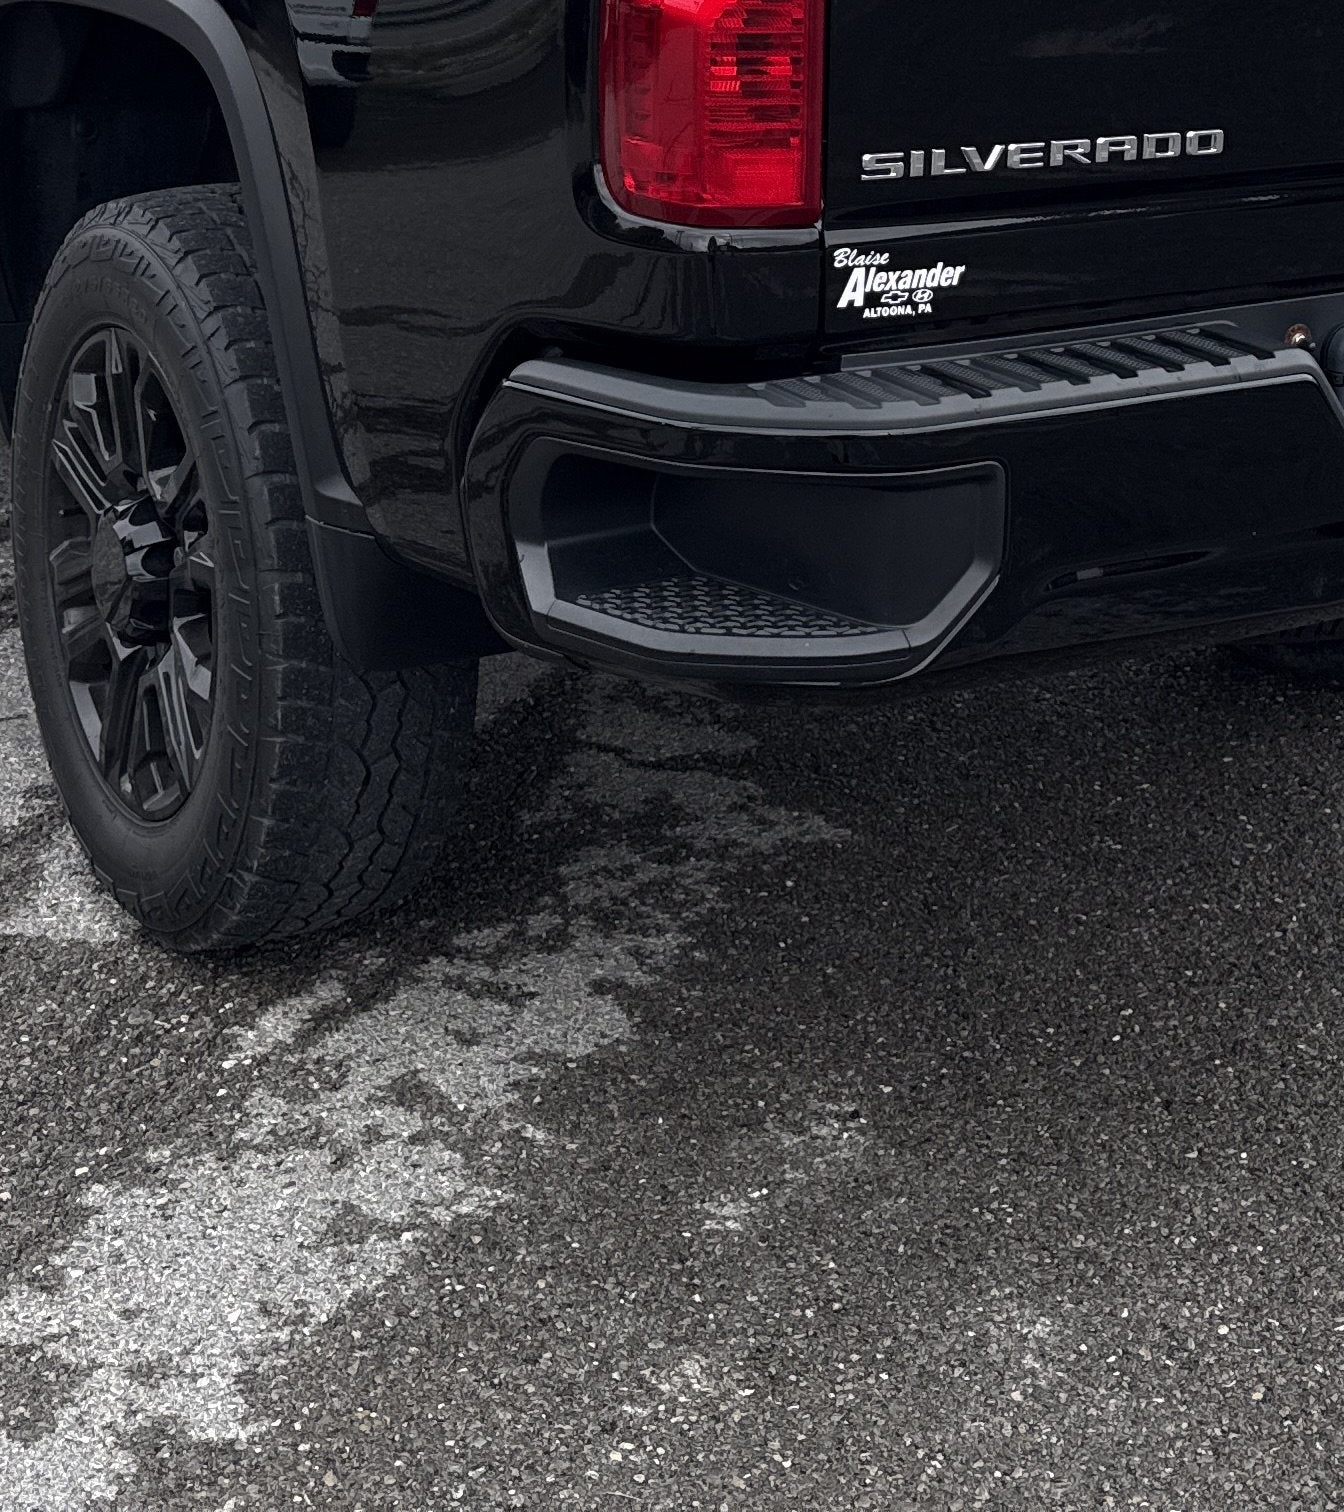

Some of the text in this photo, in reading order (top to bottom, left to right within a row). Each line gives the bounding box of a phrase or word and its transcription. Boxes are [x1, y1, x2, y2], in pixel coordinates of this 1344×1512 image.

[860, 128, 1225, 182] SILVERADO
[833, 247, 890, 268] Blaise
[836, 261, 966, 309] Alexander
[862, 302, 933, 319] ALTOONA, PA
